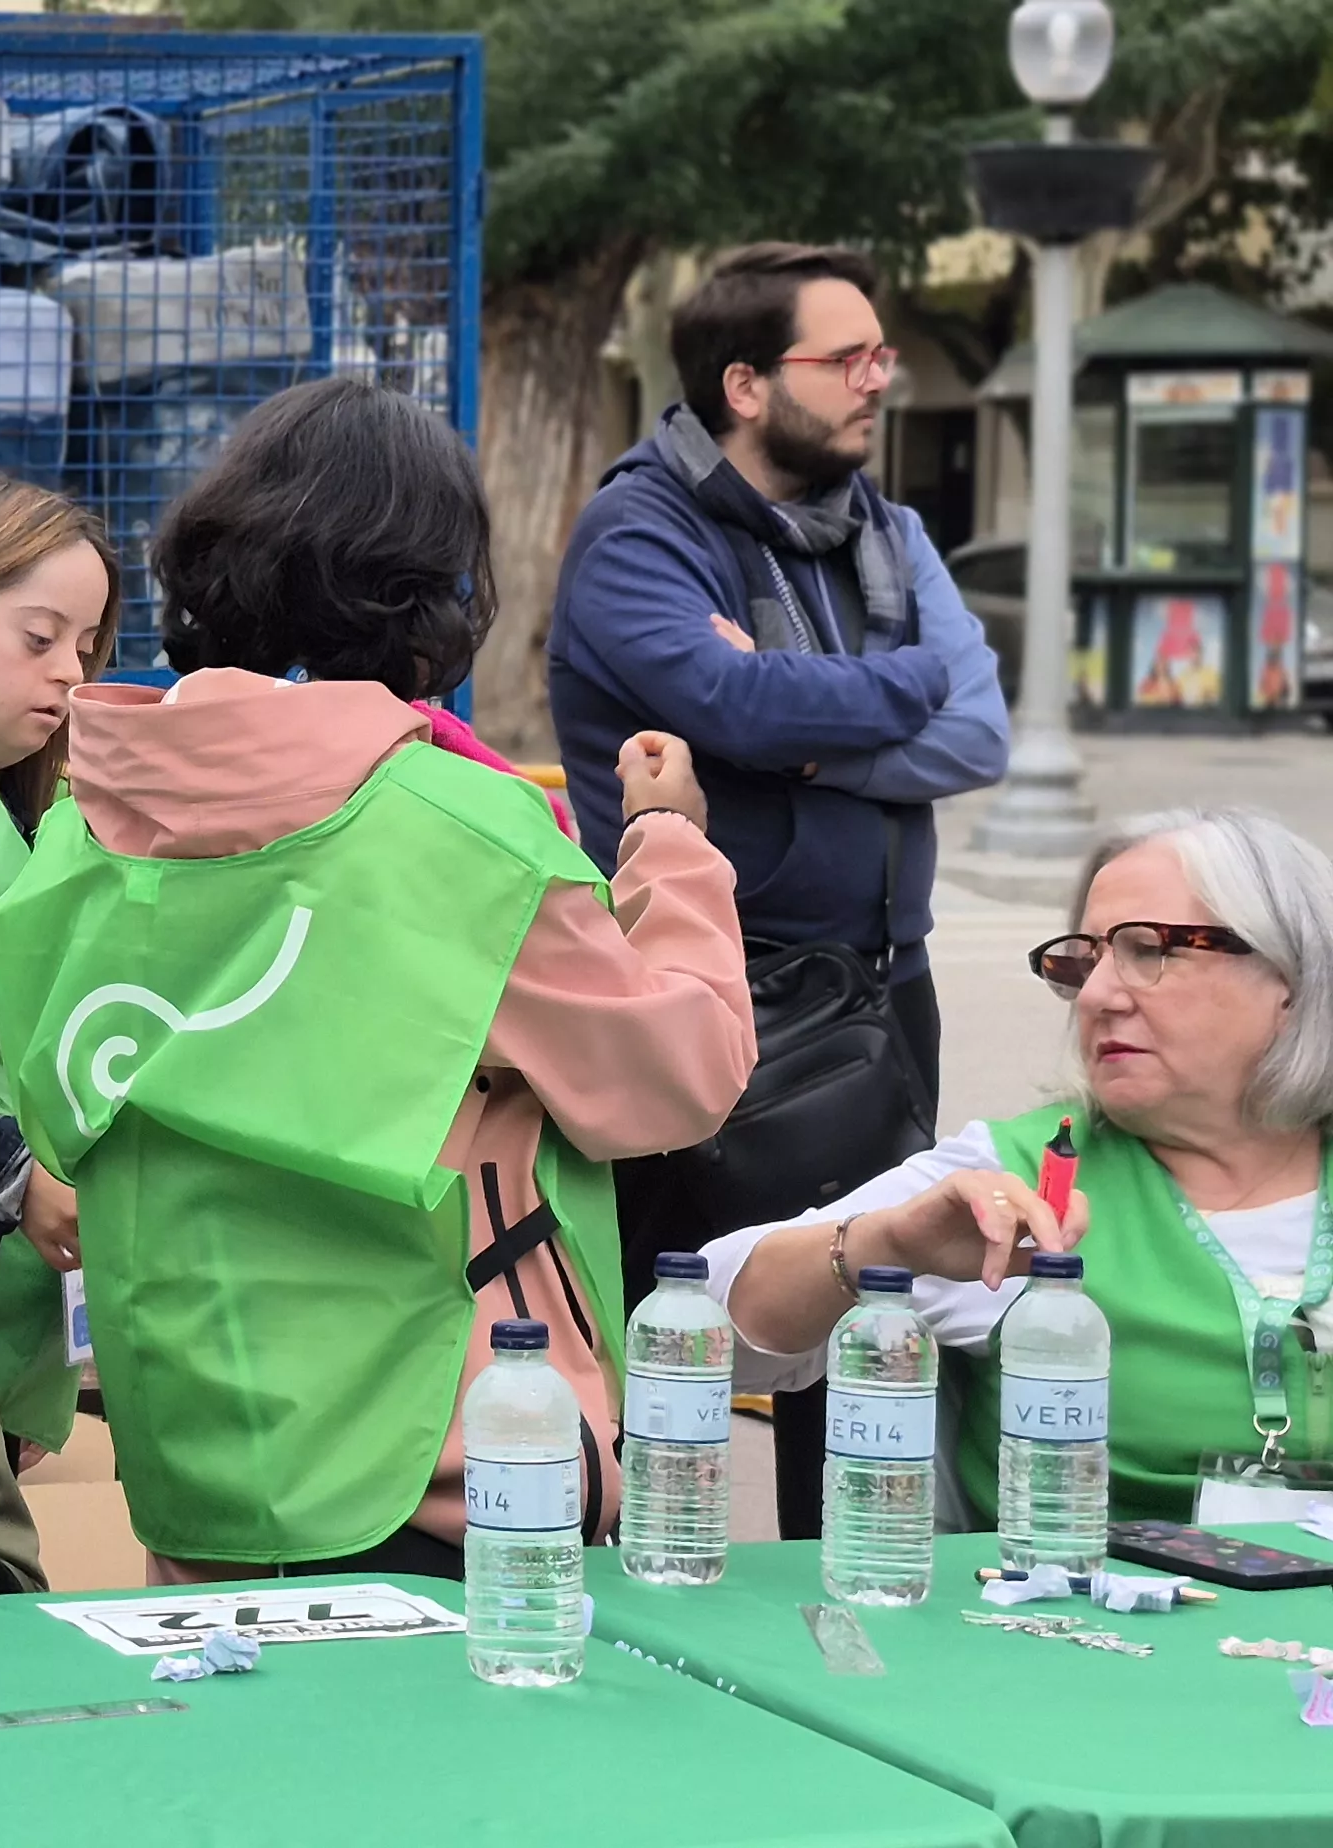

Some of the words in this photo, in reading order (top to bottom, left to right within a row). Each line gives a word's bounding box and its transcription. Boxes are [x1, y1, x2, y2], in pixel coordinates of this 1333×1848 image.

[697, 1406, 729, 1421] VER
[468, 1486, 510, 1511] RI4
[137, 1603, 375, 1629] 772
